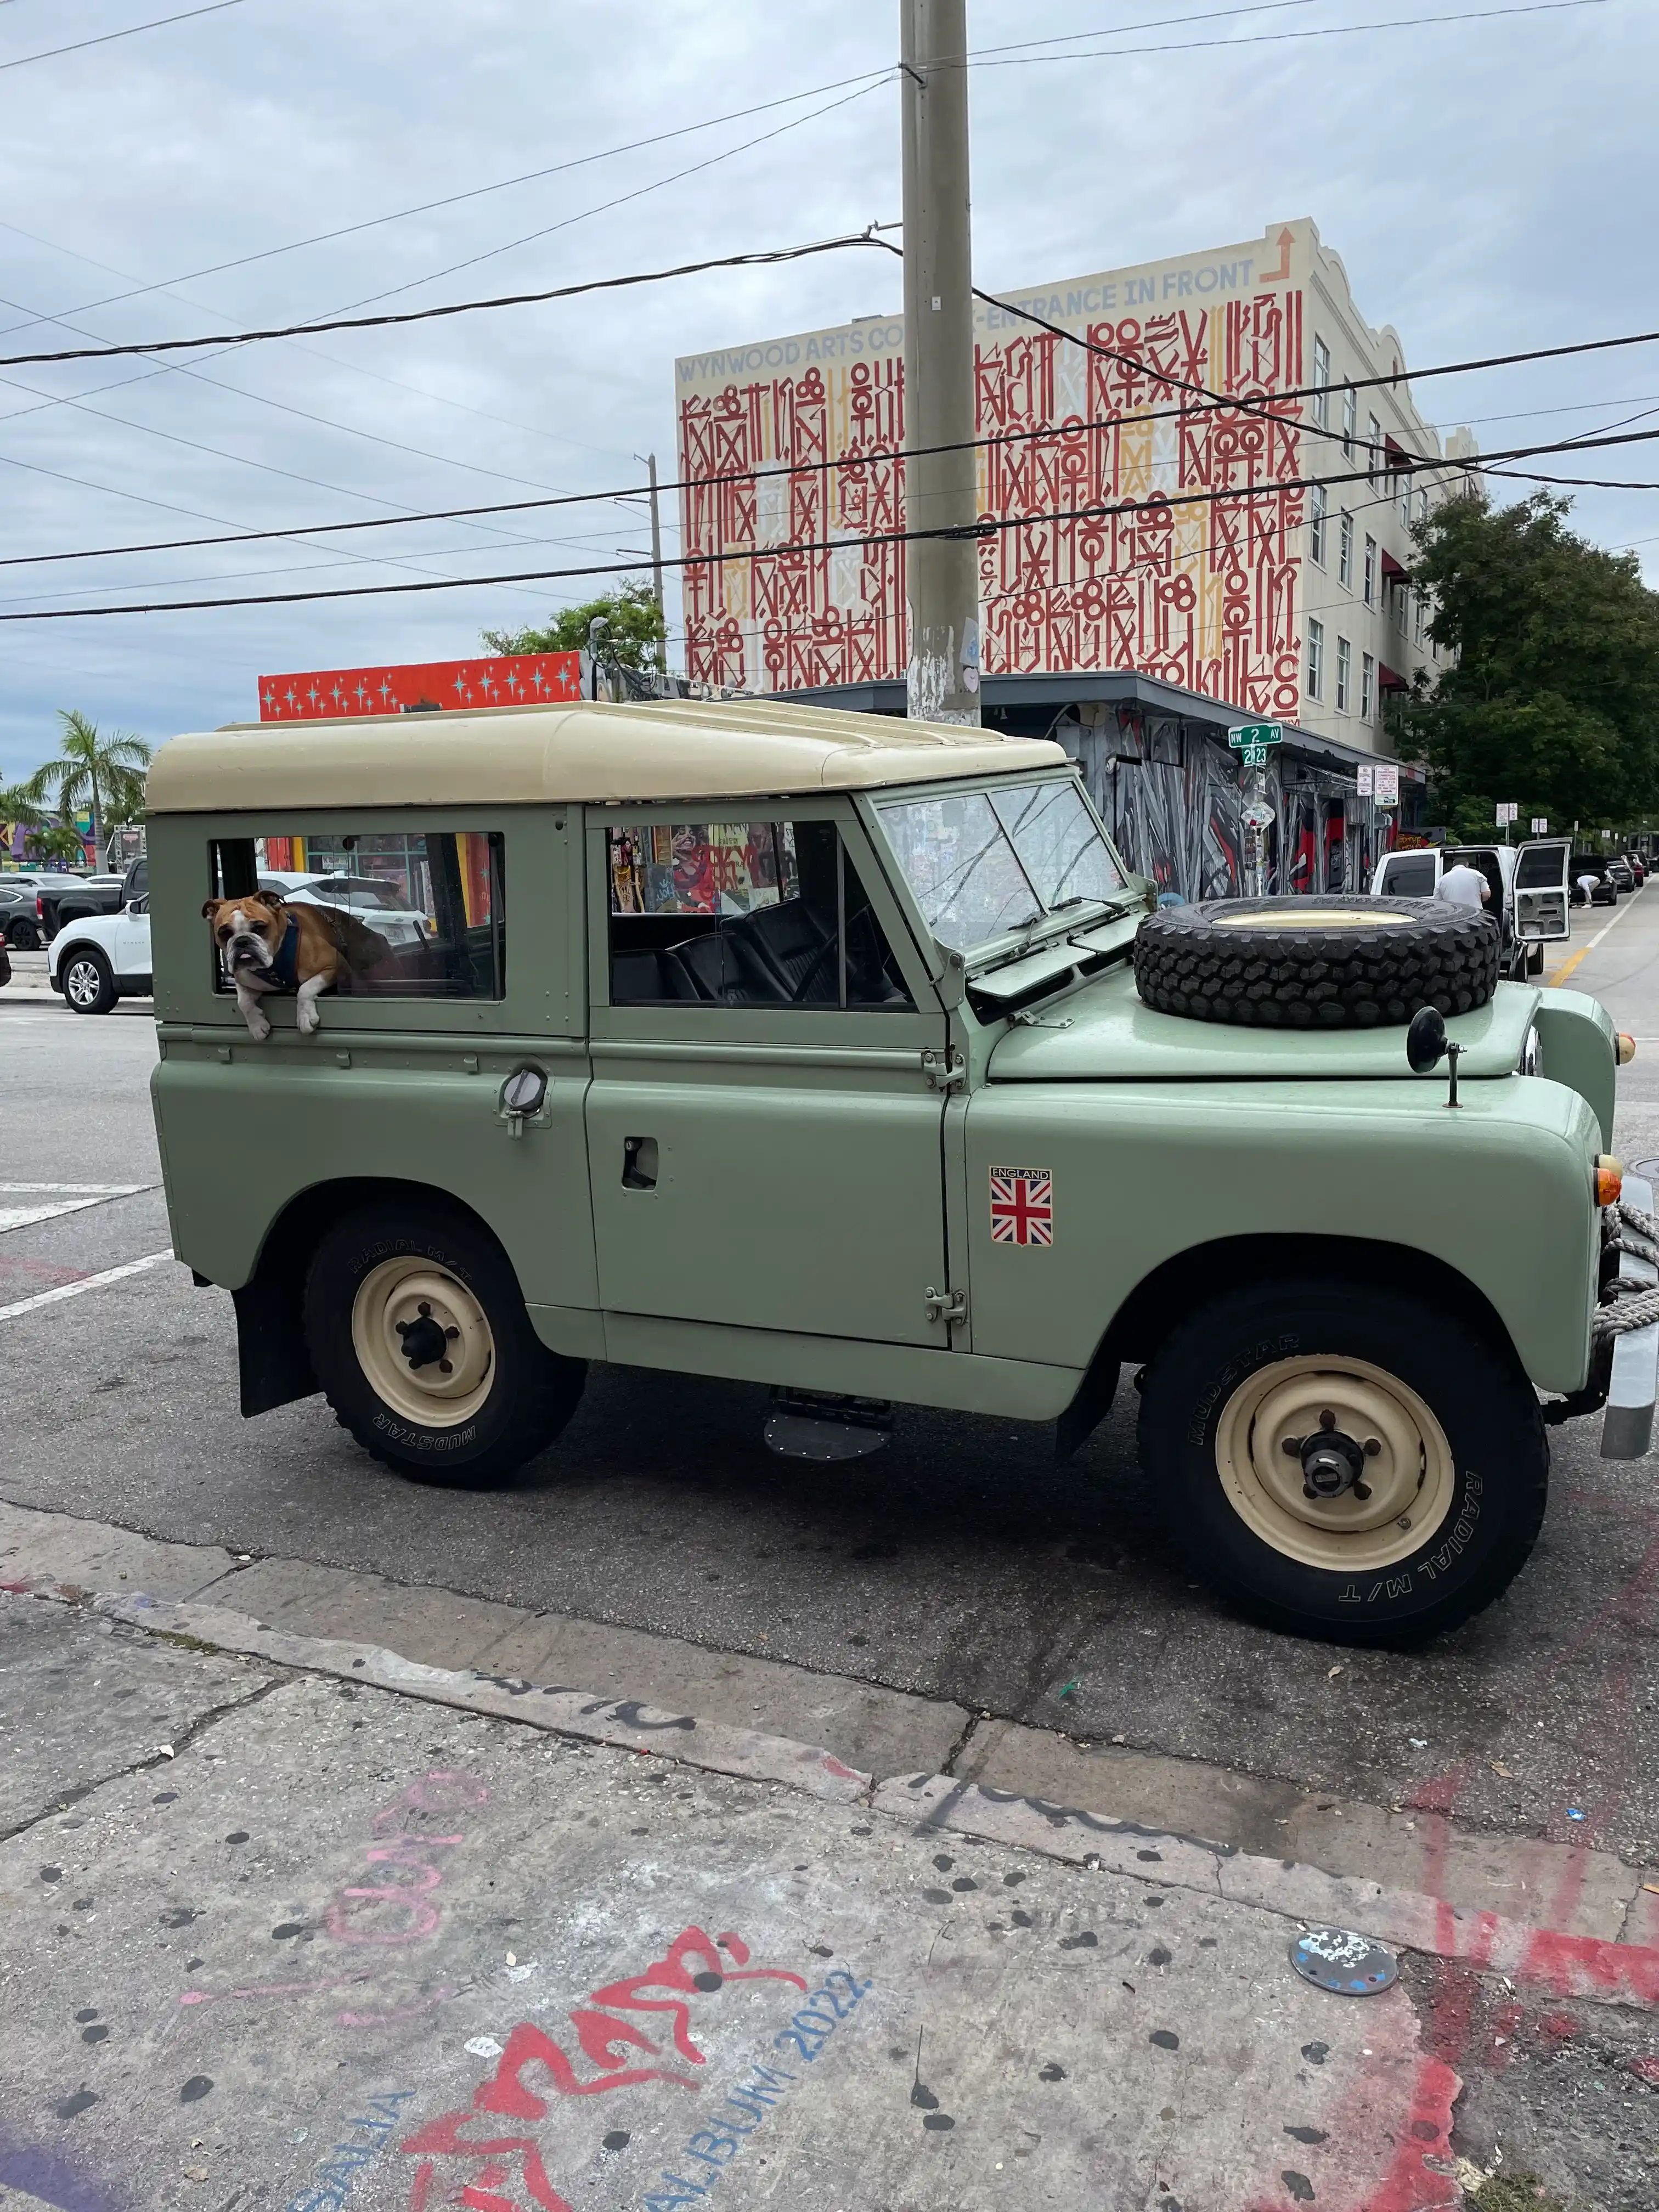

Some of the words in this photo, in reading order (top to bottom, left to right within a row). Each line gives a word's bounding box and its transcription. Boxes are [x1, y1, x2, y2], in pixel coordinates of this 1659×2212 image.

[678, 343, 800, 382] WYNWOOD
[806, 330, 865, 361] ARTS
[868, 324, 904, 351] CO
[1125, 276, 1155, 305] IN
[1163, 259, 1254, 300] FRONT
[1231, 732, 1242, 743] NW
[1251, 728, 1260, 743] 2
[1270, 728, 1279, 739] AV
[992, 1168, 1049, 1180] ENGLAND
[347, 1239, 422, 1274] RADIAL
[427, 1246, 473, 1280] M/T
[1187, 1334, 1300, 1446] MUDSTAR
[372, 1413, 477, 1451] MUDSTAR
[1417, 1470, 1483, 1580] RADIAL
[1338, 1573, 1413, 1602] M/T
[644, 2064, 797, 2212] ALBUM
[774, 1969, 873, 2062] 2022
